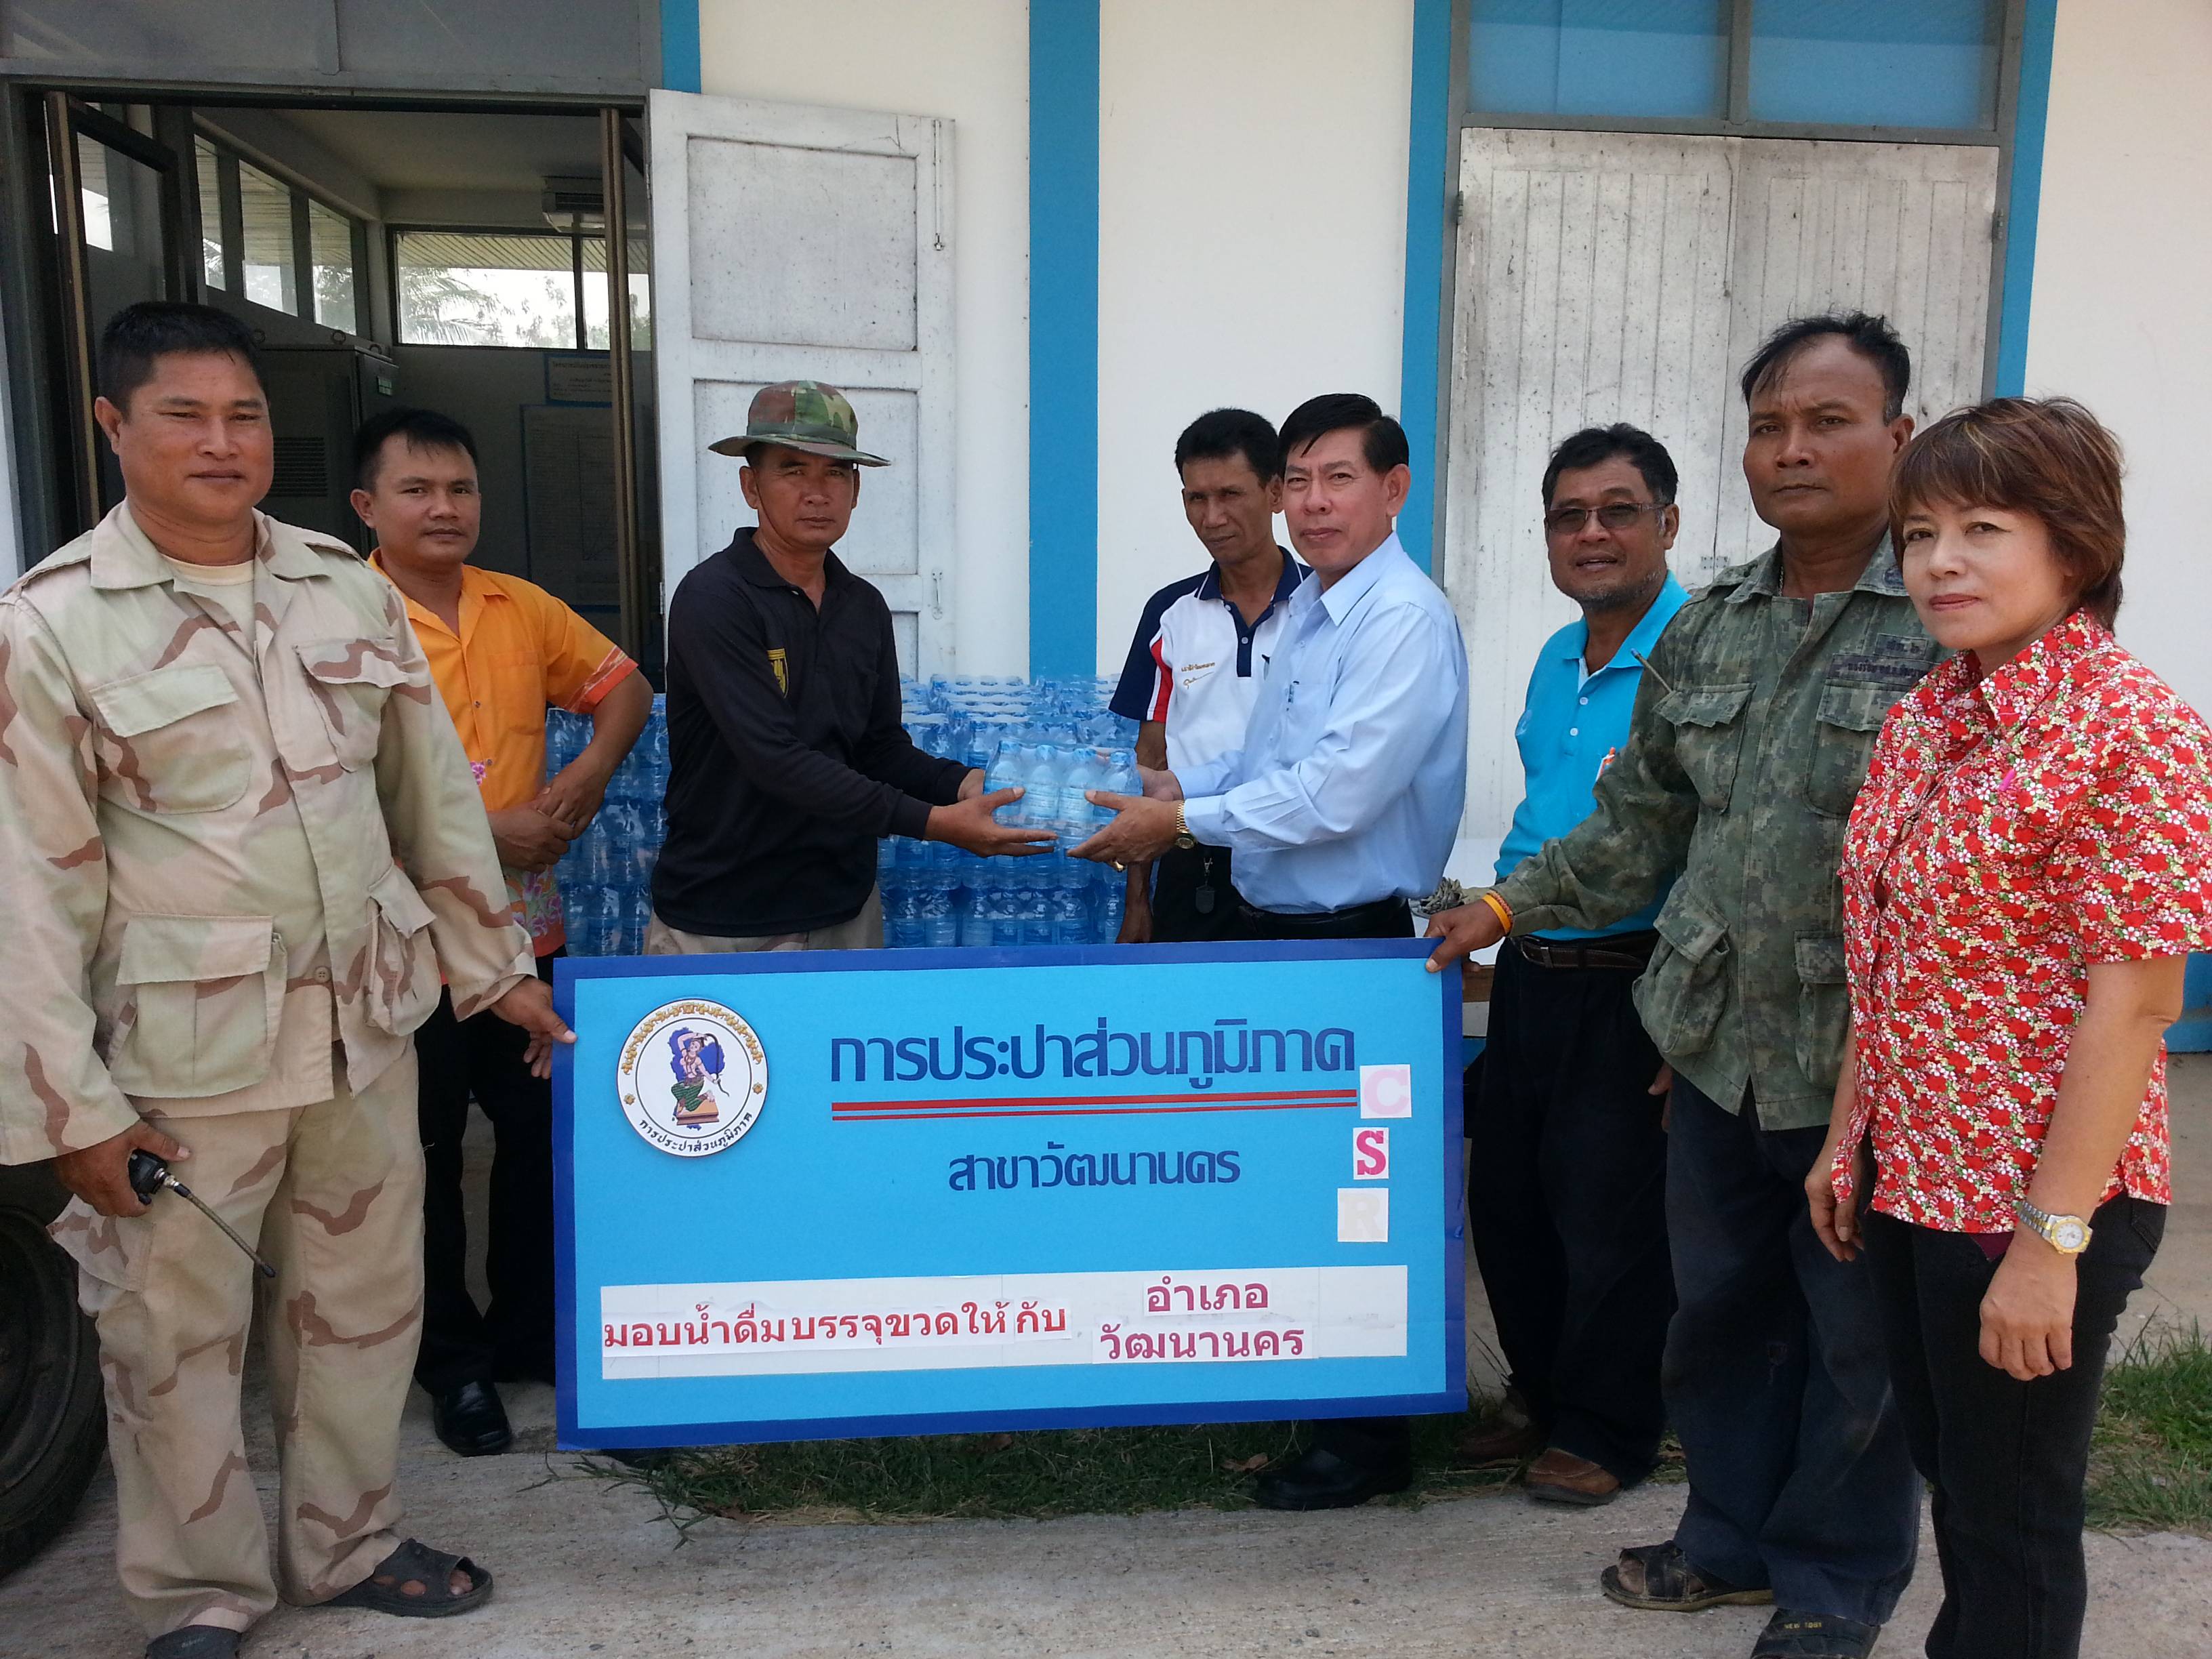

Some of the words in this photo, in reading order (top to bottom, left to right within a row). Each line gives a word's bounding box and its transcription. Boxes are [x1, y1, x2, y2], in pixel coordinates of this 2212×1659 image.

[831, 1017, 1355, 1089] การประปาส่วนภูมิภาค
[1364, 1068, 1410, 1115] C
[639, 1111, 753, 1153] การประปาส่วนภูมิภาค
[1356, 1130, 1387, 1176] S
[949, 1141, 1241, 1191] สาขาวัฒนานคร
[1147, 1275, 1269, 1313] อำเภอ
[1100, 1323, 1305, 1359] วัฒนานคร
